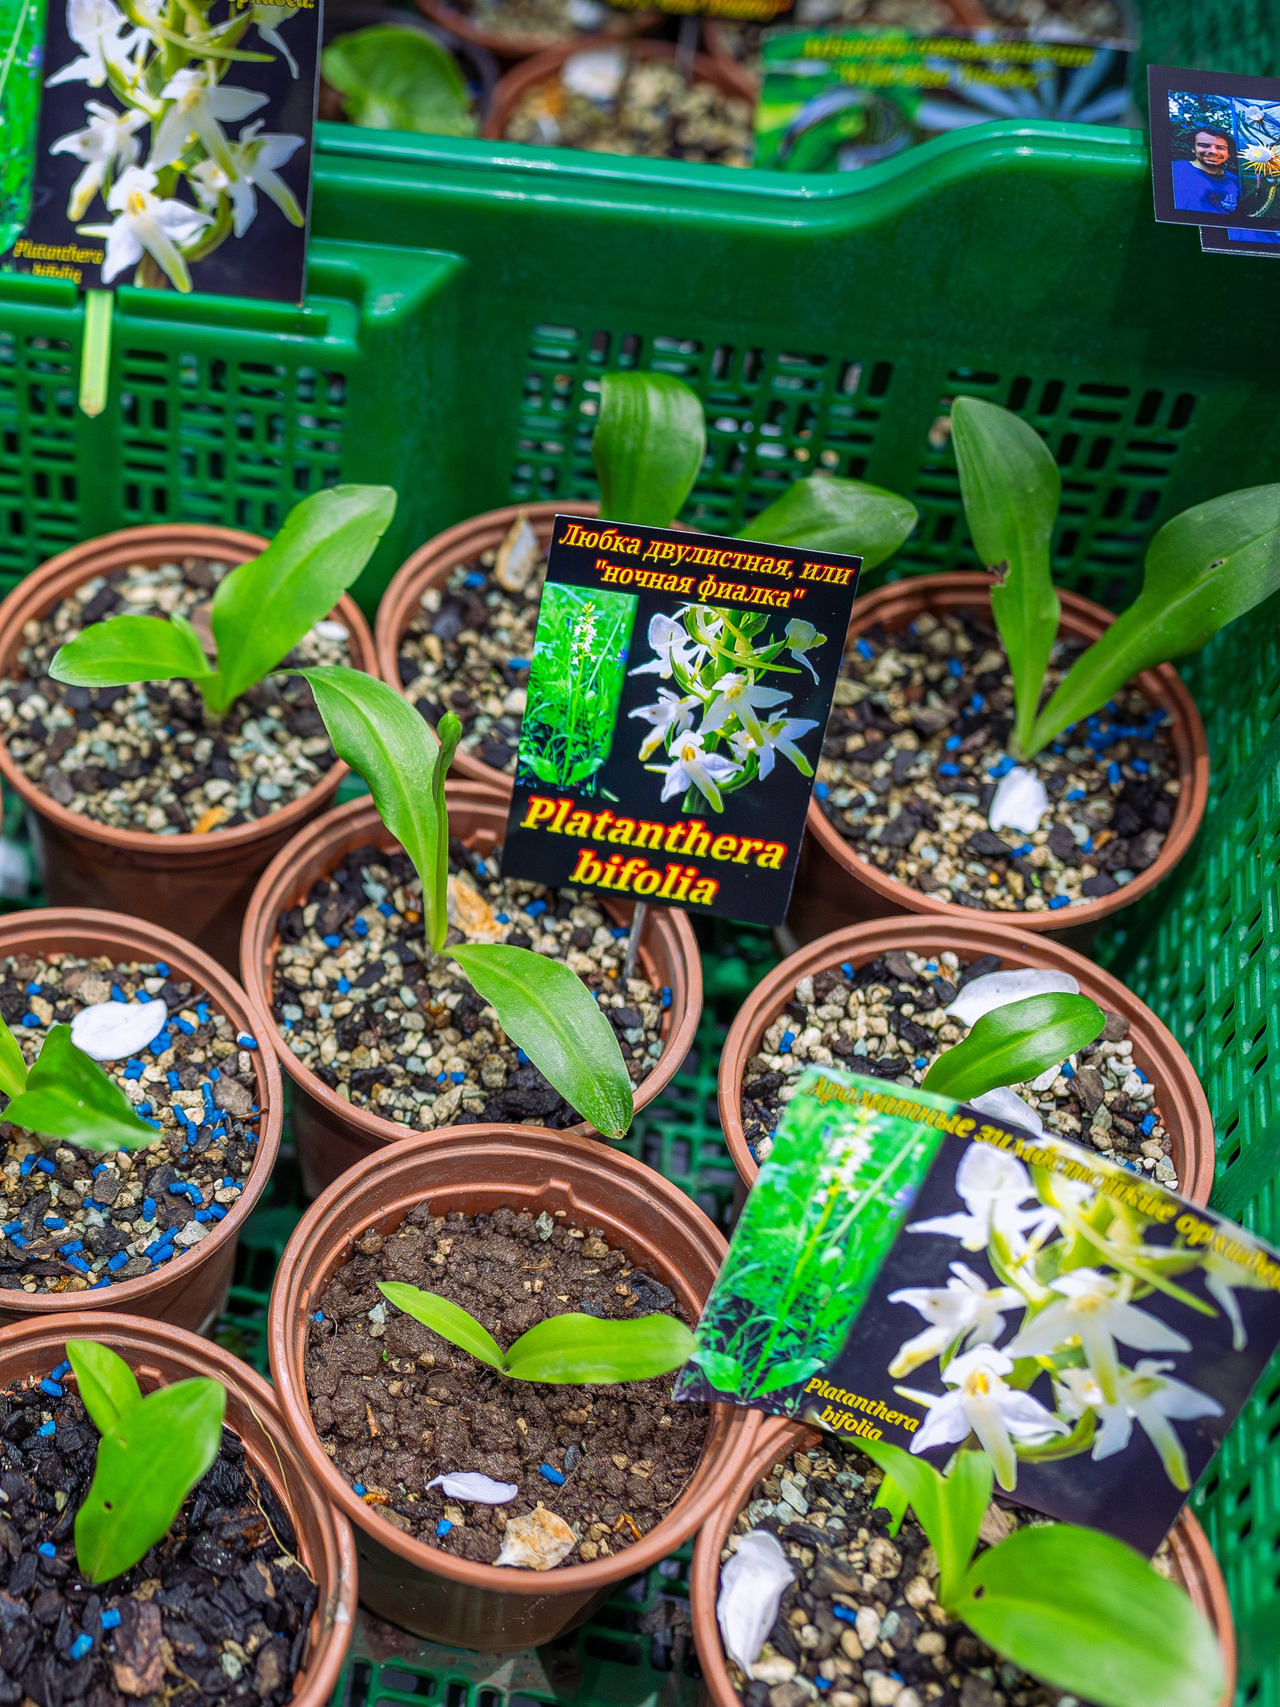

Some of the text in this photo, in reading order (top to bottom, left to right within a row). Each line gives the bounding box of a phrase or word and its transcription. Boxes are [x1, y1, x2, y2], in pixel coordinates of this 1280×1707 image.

[558, 523, 855, 586] Любка двулистная, или
[595, 559, 806, 608] "ночная фиалка"
[520, 794, 788, 870] Platanthera
[568, 848, 720, 906] bifolia
[803, 1377, 920, 1432] Platanthera
[819, 1404, 883, 1441] bifolia
